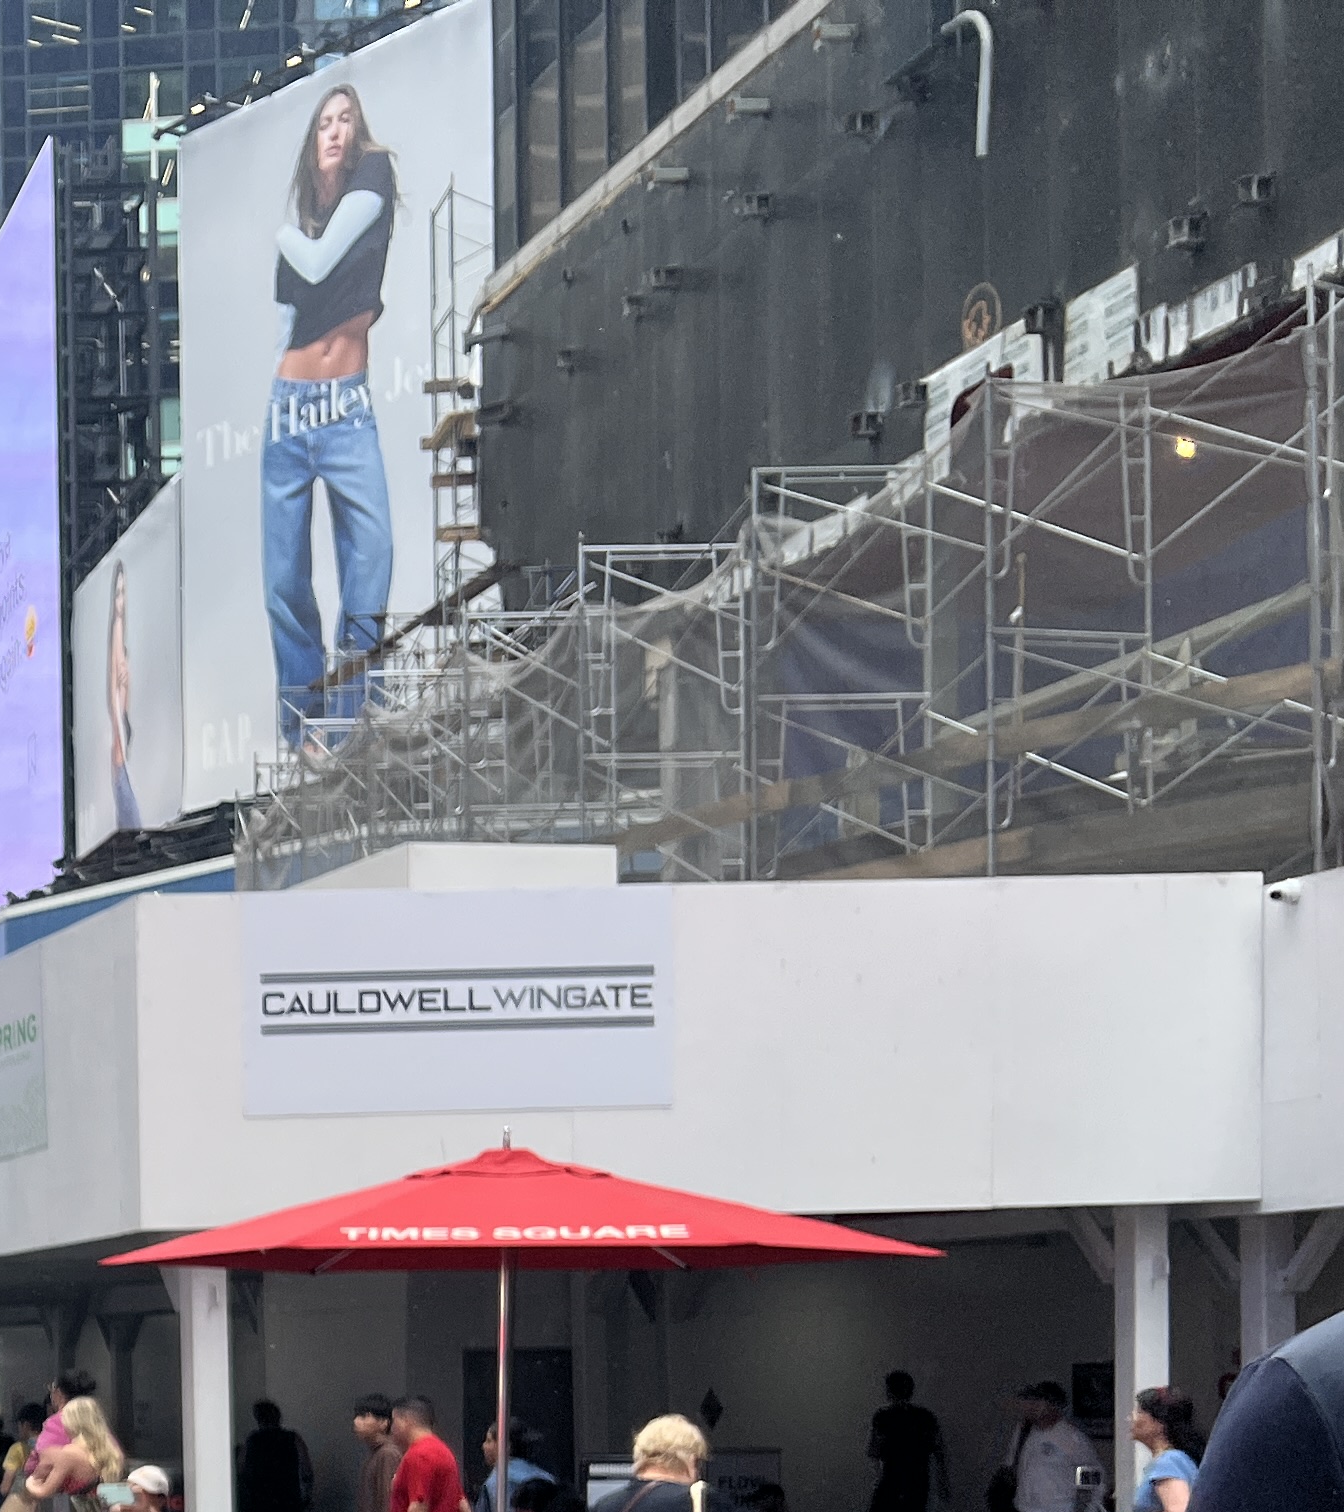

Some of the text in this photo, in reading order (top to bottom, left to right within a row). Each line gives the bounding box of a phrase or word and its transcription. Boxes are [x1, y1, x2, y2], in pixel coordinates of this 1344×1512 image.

[270, 377, 372, 444] Hailey
[262, 983, 653, 1016] CAULDWELL WINGATE
[340, 1224, 691, 1241] TIMES SQUARE
